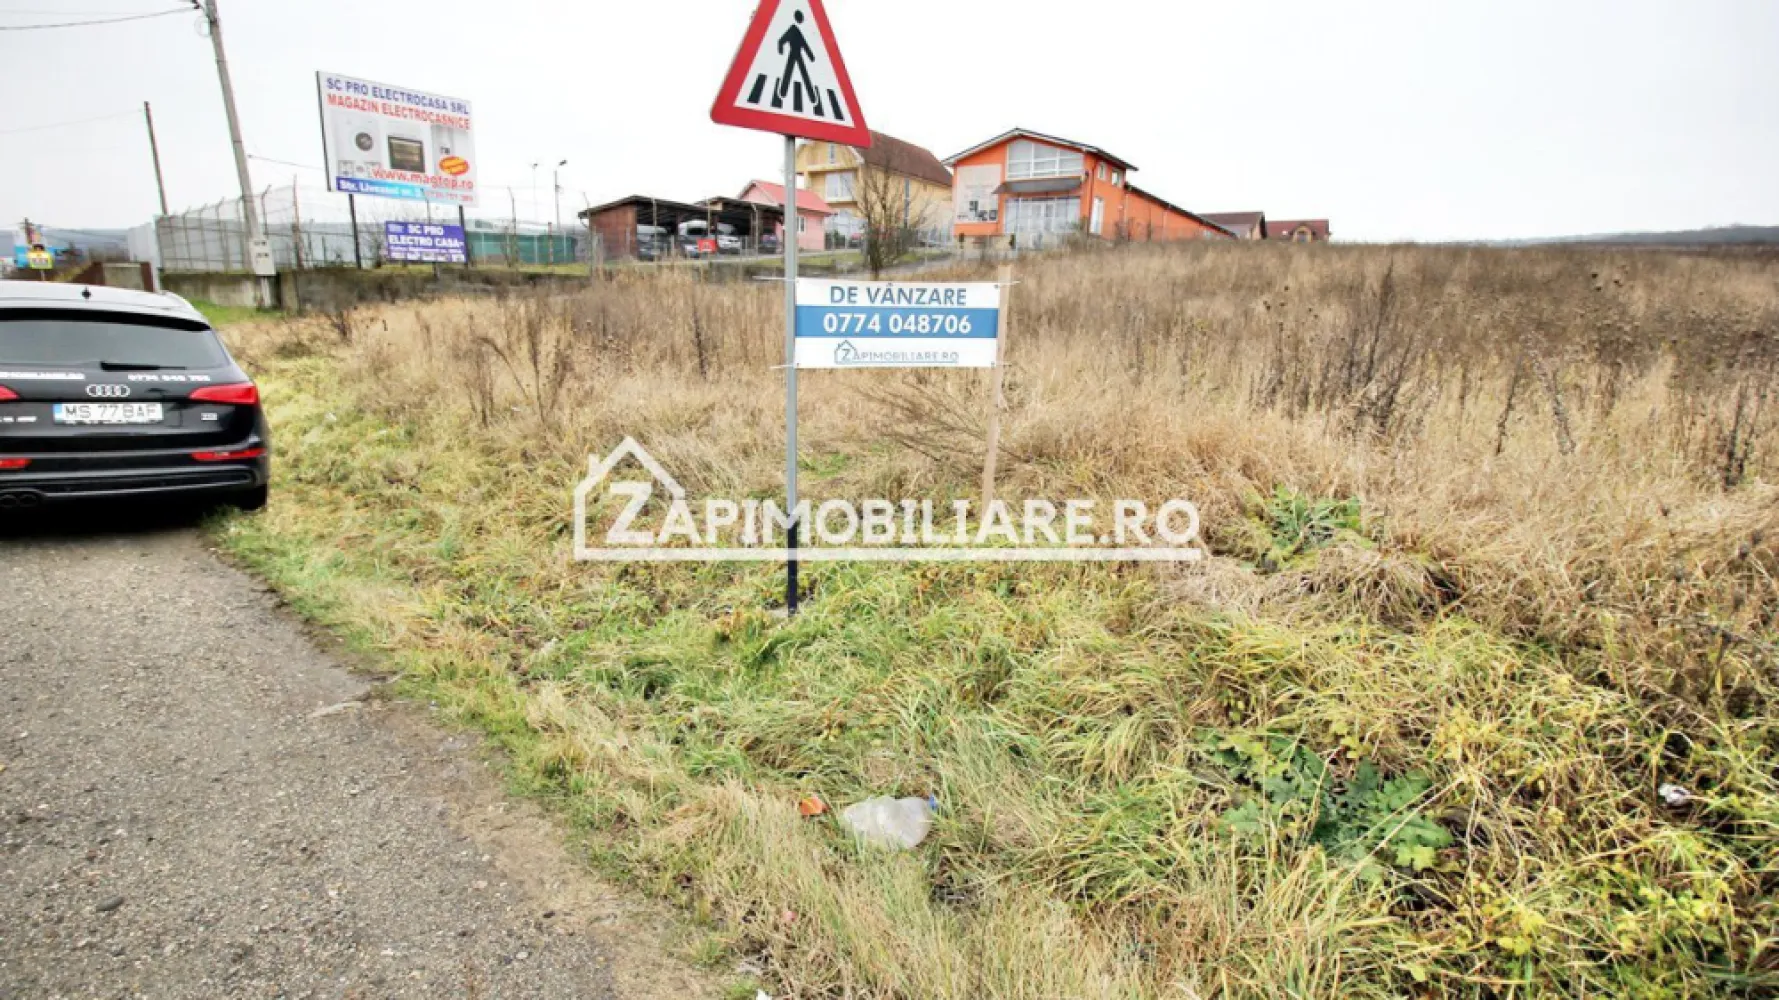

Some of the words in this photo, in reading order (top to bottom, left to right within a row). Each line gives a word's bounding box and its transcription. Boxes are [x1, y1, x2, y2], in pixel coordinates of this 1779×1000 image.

[326, 78, 343, 91] SC
[345, 81, 369, 96] PRO
[372, 86, 448, 110] ELECTROCASA
[450, 100, 469, 115] SRL
[327, 93, 380, 113] MAGAZIN
[382, 102, 470, 129] ELECTROCASNICE
[387, 234, 433, 246] ELECTRO
[407, 223, 422, 234] SC
[423, 225, 444, 236] PRO
[830, 286, 858, 304] DE
[866, 282, 967, 306] VÂNZARE
[823, 312, 881, 333] 0774
[888, 314, 972, 334] 048706
[65, 405, 91, 419] MS
[97, 405, 118, 419] 77
